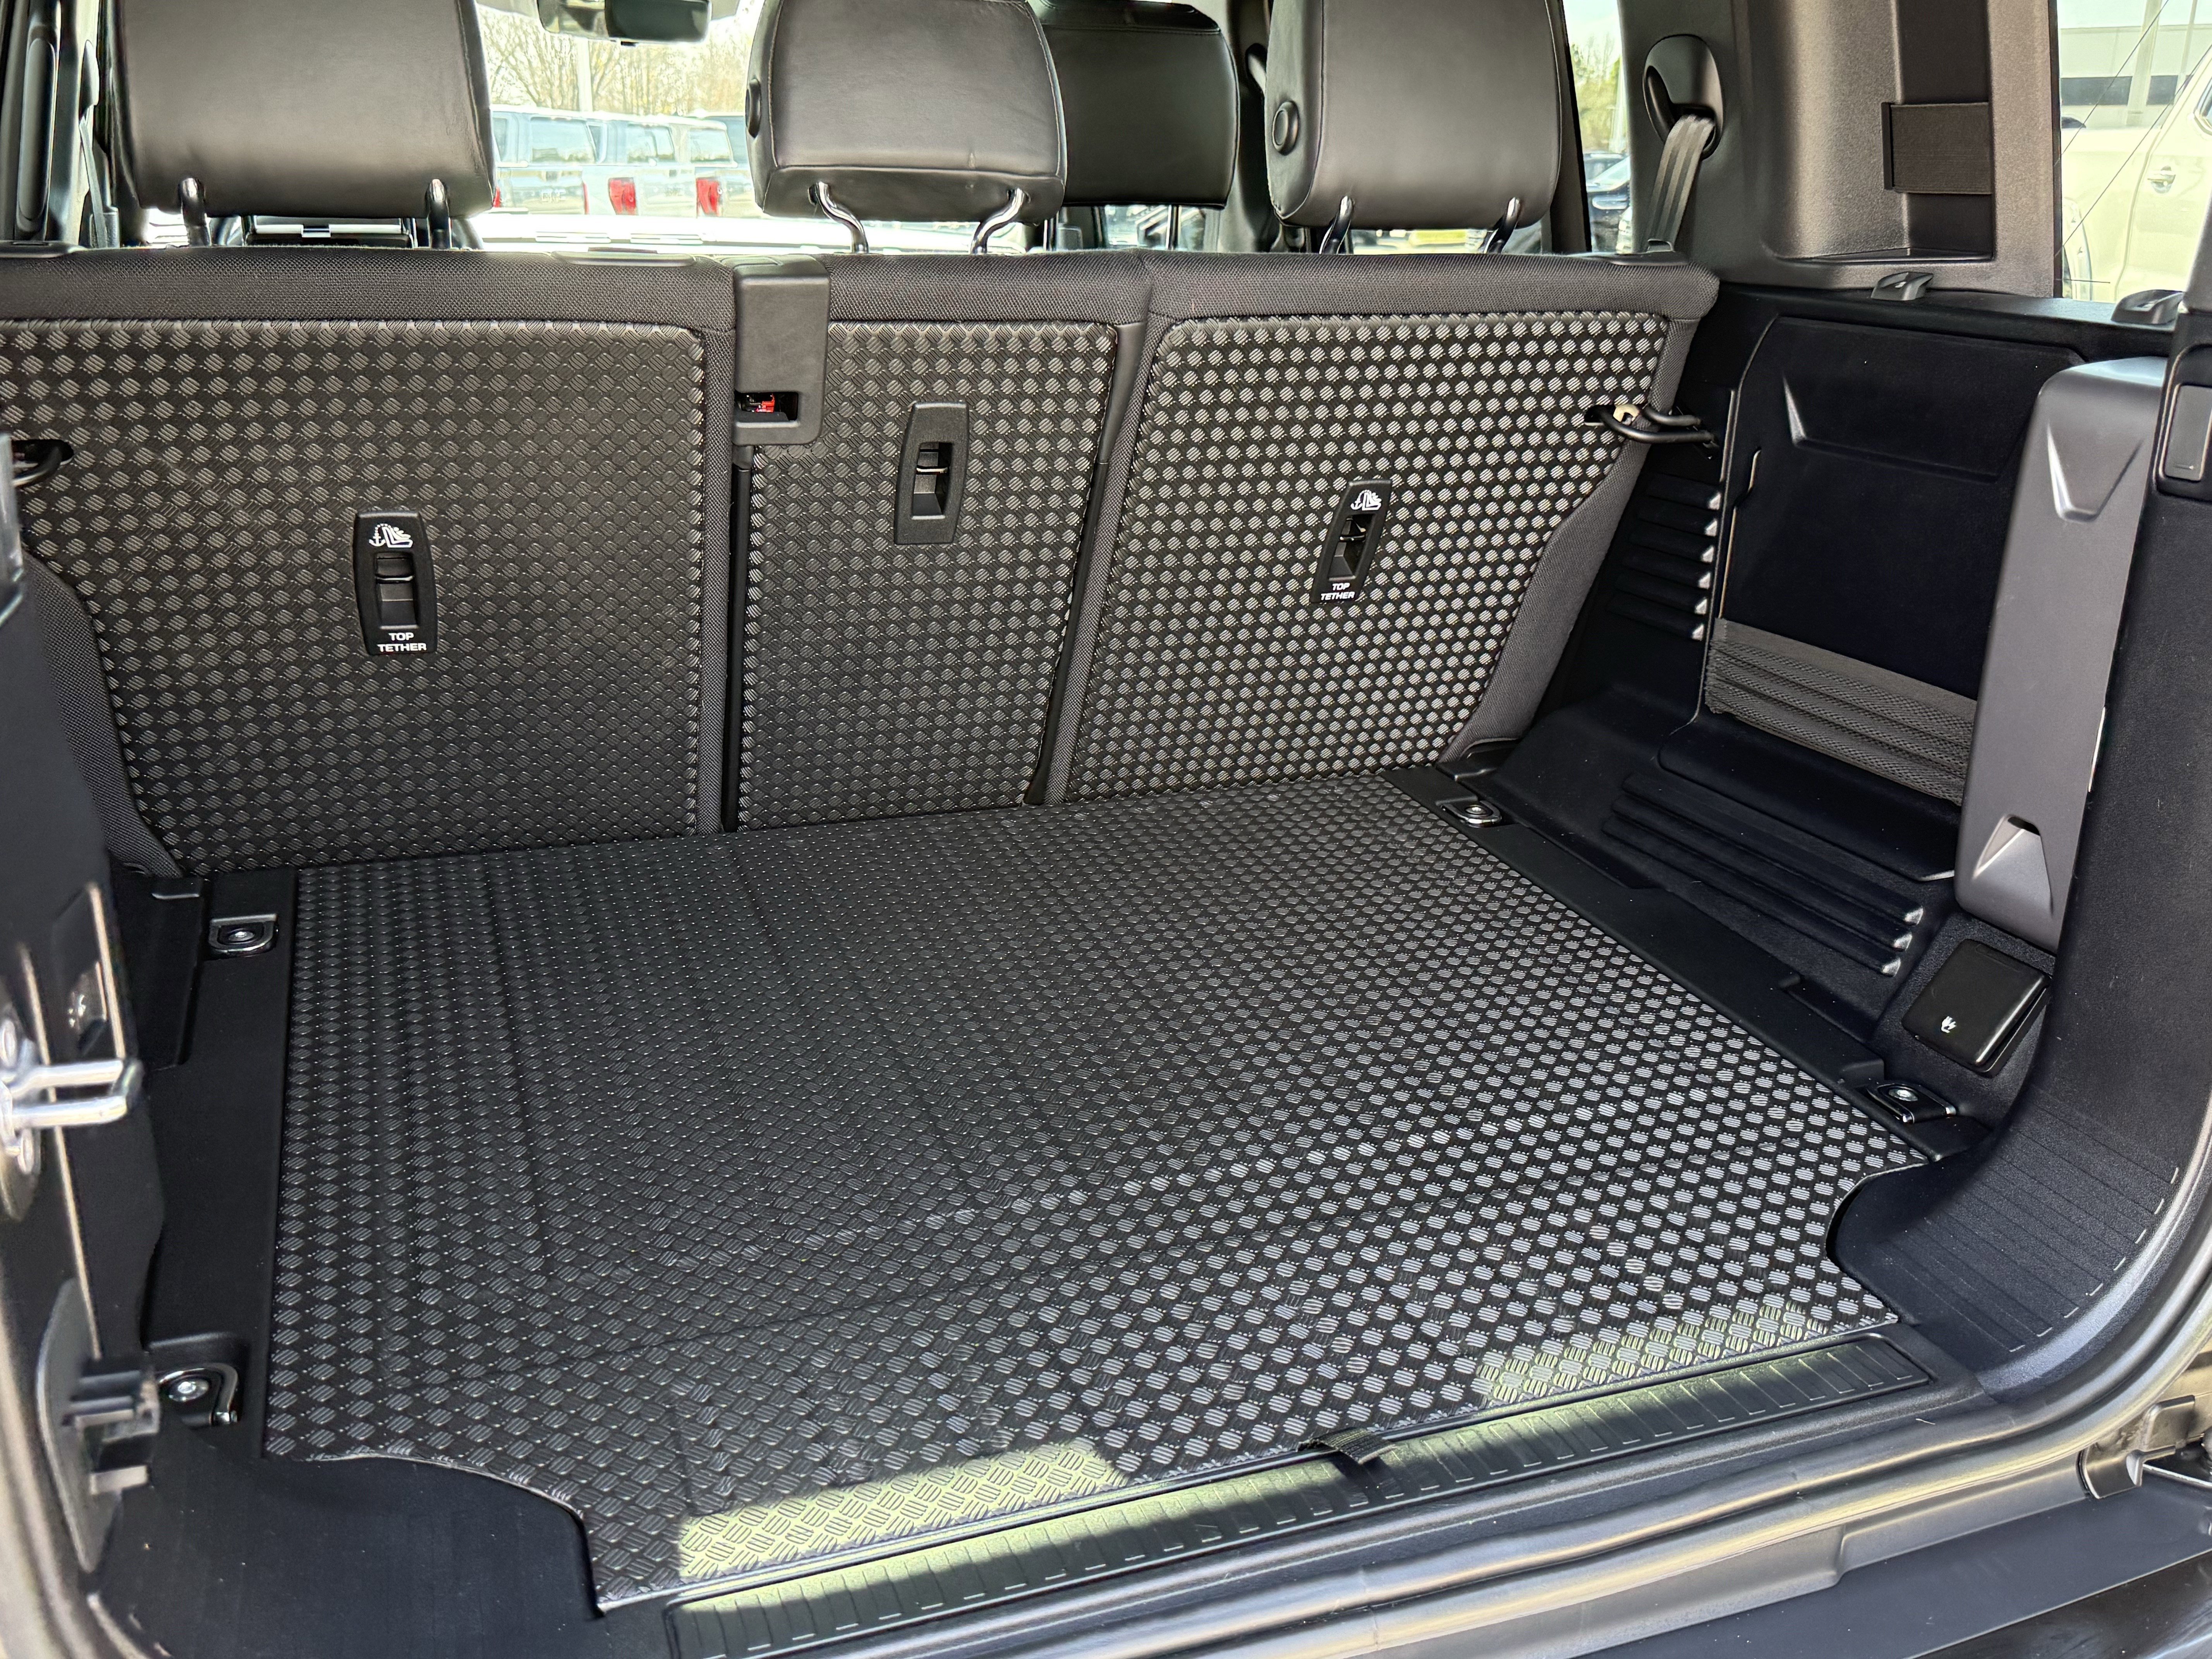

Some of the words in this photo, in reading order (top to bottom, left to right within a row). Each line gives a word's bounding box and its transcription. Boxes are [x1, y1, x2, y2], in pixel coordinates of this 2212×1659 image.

[1332, 582, 1350, 591] TOP
[1321, 591, 1355, 600] TETHER
[388, 632, 414, 641] TOP
[377, 642, 427, 652] TETHER
